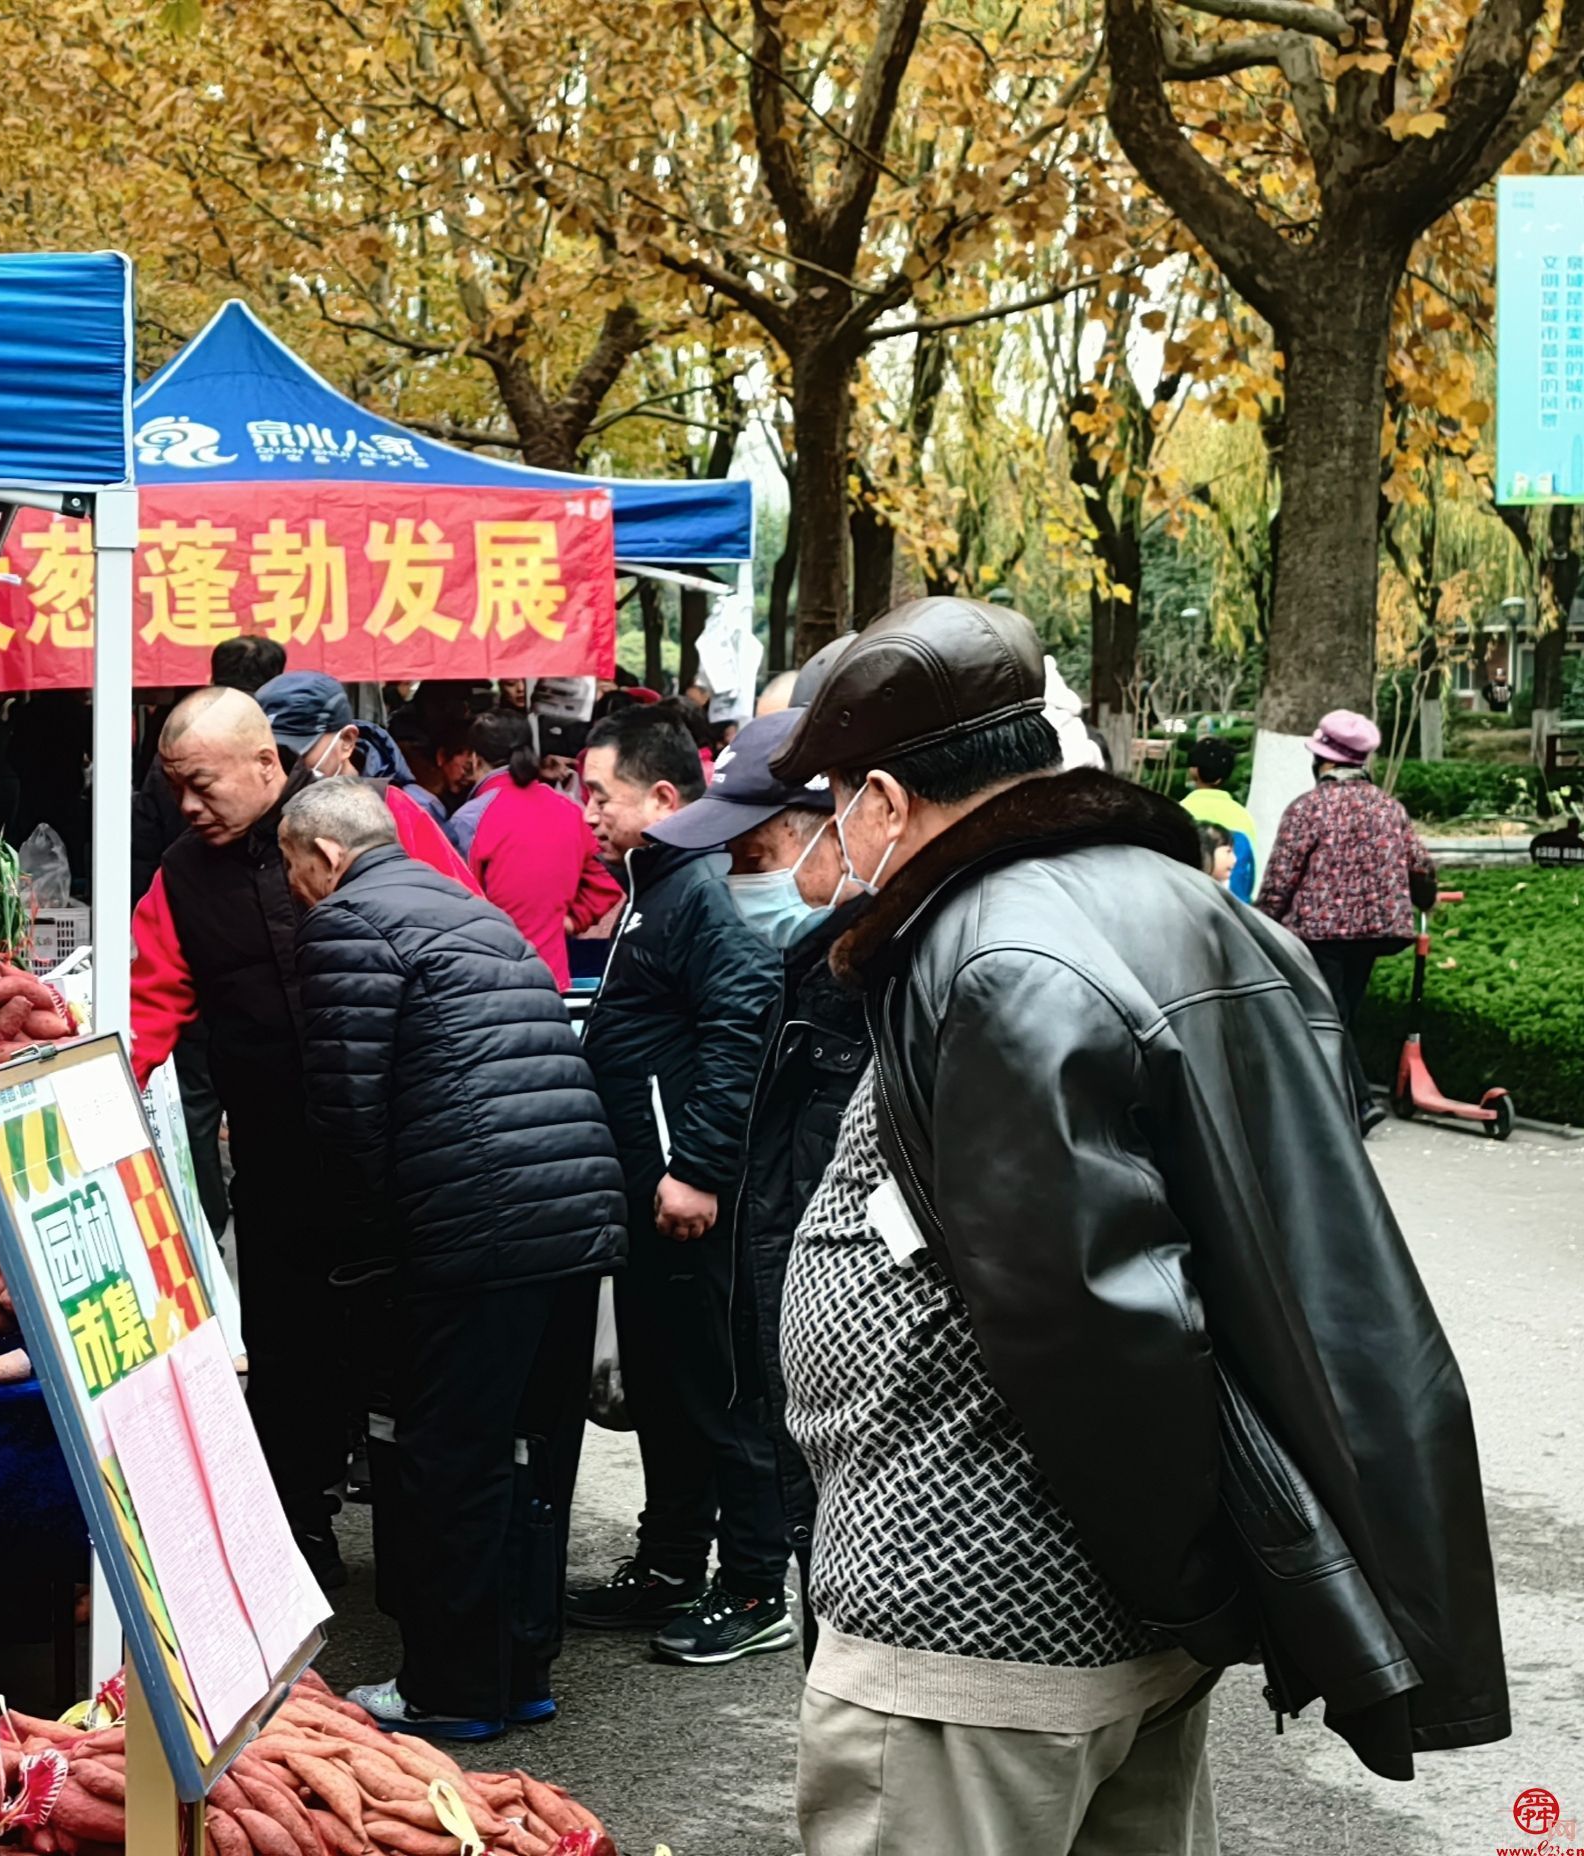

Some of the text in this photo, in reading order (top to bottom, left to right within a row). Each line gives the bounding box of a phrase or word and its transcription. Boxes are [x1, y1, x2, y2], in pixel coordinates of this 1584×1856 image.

[246, 420, 419, 457] 泉水人家
[33, 1187, 123, 1302] 园林
[67, 1279, 153, 1390] 市集
